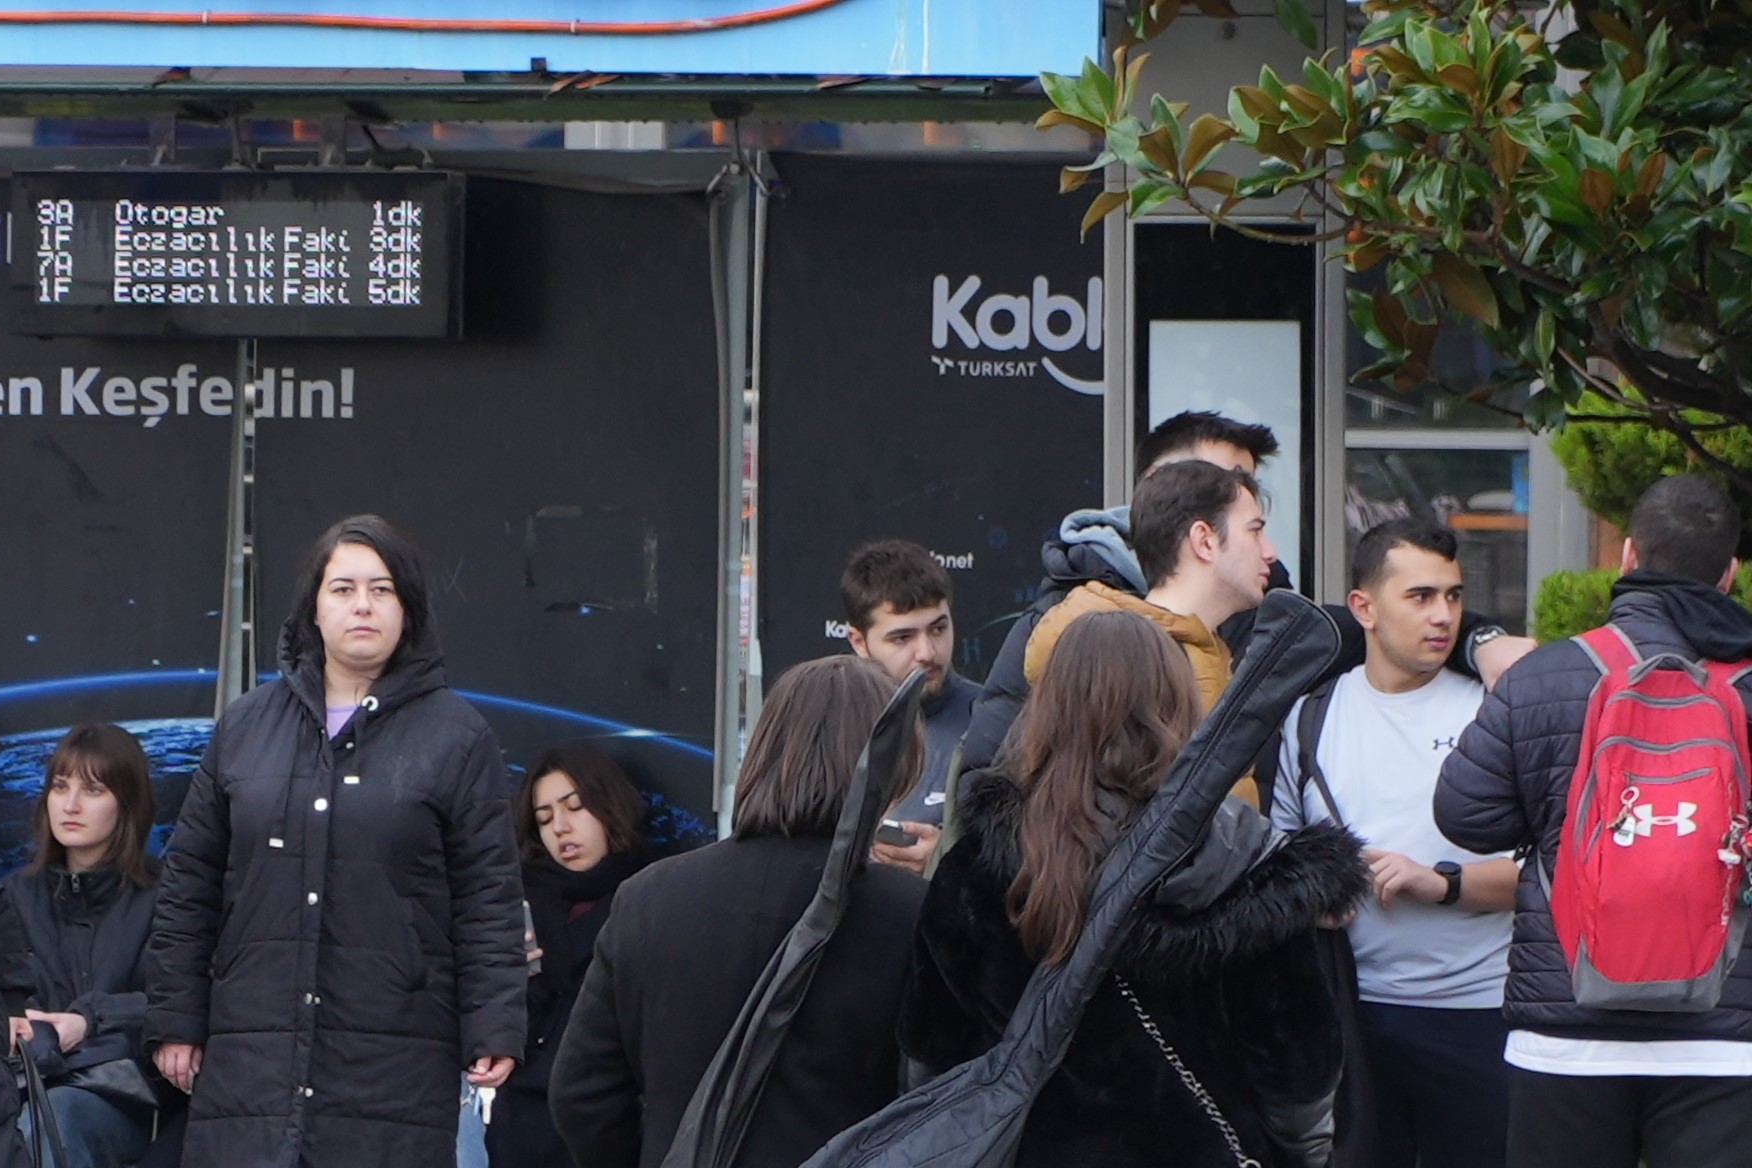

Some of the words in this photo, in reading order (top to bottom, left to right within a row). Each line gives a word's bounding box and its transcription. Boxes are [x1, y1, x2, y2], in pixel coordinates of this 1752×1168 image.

[36, 199, 74, 226] 3A
[114, 199, 226, 229] Otogar
[372, 200, 423, 226] 1dk
[38, 226, 74, 252] 1F
[114, 226, 275, 252] Eczacılık
[282, 226, 351, 252] Faki
[368, 226, 423, 252] 3dk
[36, 252, 74, 278] 7A
[114, 252, 275, 278] Eczacılık
[282, 252, 351, 278] Faki
[368, 252, 423, 278] 4dk
[37, 278, 73, 303] 1F
[113, 278, 275, 304] Eczacılık
[282, 278, 351, 304] Faki
[368, 278, 422, 304] 5dk
[931, 273, 1105, 351] Kabl
[60, 364, 355, 429] Keşfedin!
